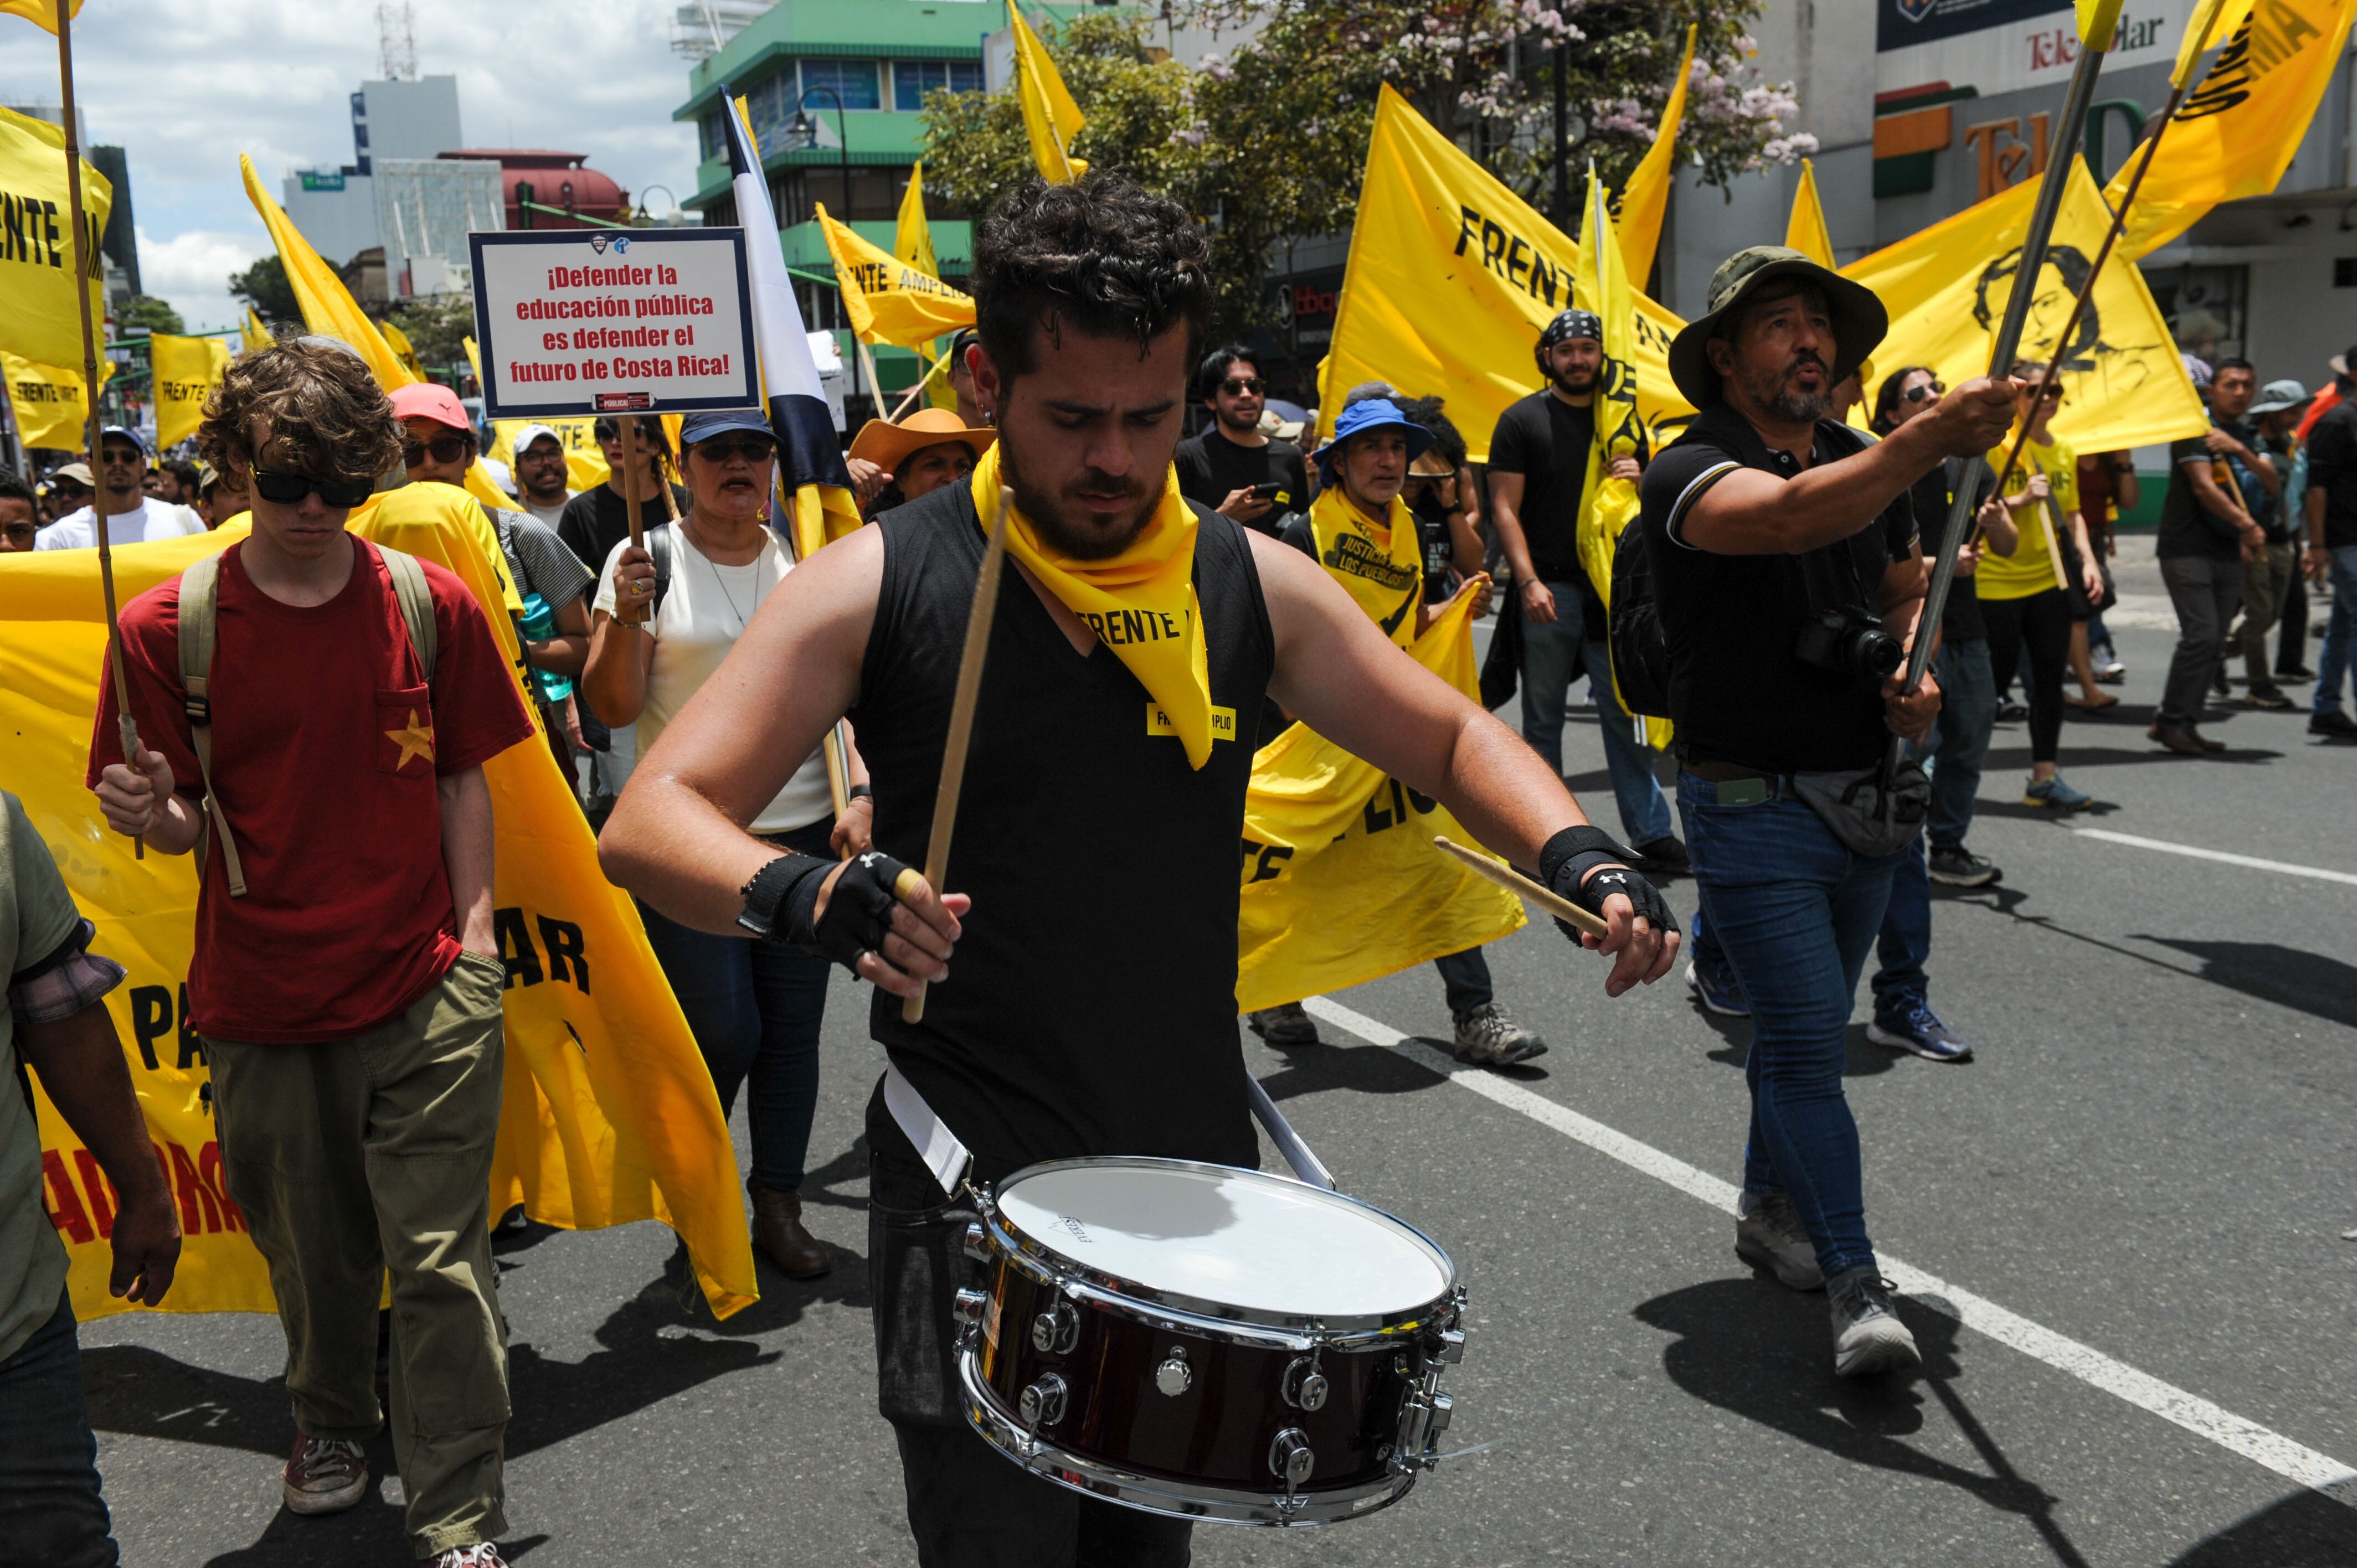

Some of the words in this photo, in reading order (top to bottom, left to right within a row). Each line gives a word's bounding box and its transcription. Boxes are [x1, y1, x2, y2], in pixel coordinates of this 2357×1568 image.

[0, 190, 62, 268] NTE
[548, 265, 653, 290] ¡Defender
[657, 264, 677, 285] la
[516, 295, 630, 320] educación
[635, 295, 713, 318] pública
[543, 332, 569, 350] es
[573, 326, 669, 349] defender
[675, 324, 694, 345] el
[511, 362, 577, 383] futuro
[581, 359, 608, 380] de
[613, 357, 673, 379] Costa
[677, 354, 729, 376] Rica!
[1339, 554, 1360, 573] LOS
[1358, 564, 1404, 586] PUEBLOS
